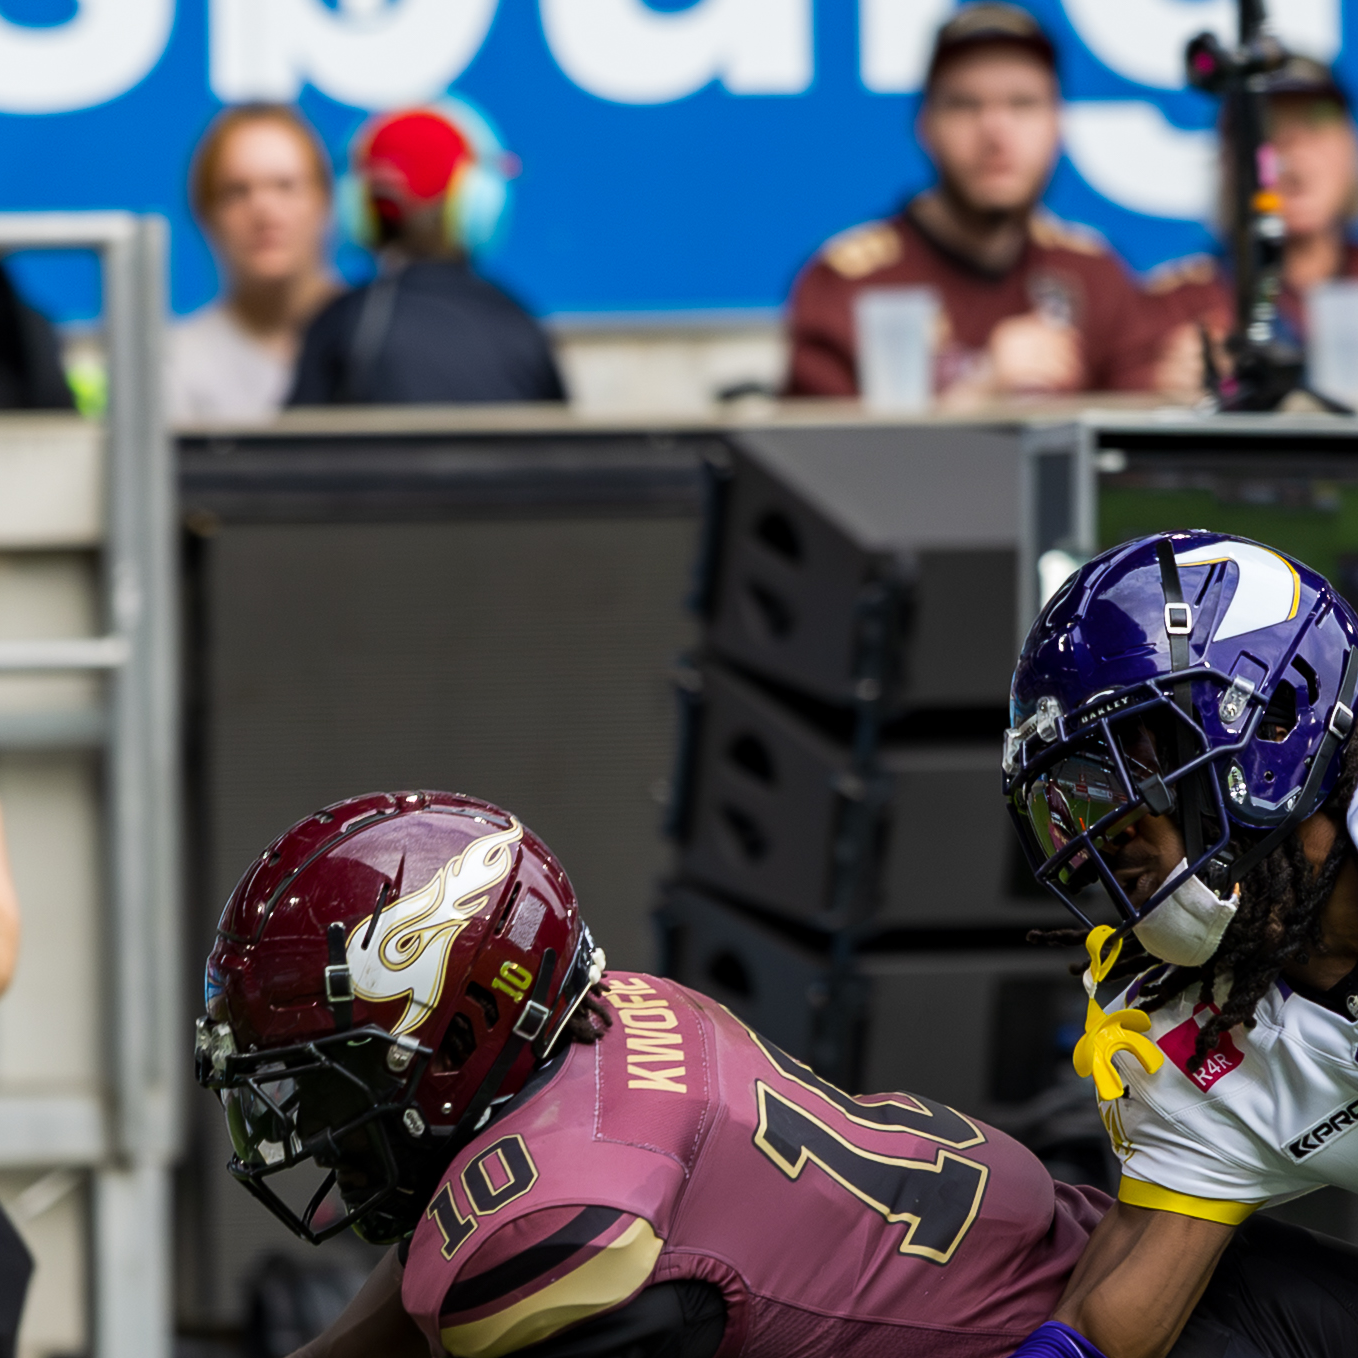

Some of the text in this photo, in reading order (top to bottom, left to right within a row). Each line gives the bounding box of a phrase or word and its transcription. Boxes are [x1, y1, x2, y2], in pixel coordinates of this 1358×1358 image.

[1081, 696, 1129, 723] OAKLEY
[491, 961, 533, 1004] 10
[1192, 1053, 1233, 1086] R4R
[426, 1133, 540, 1261] 10
